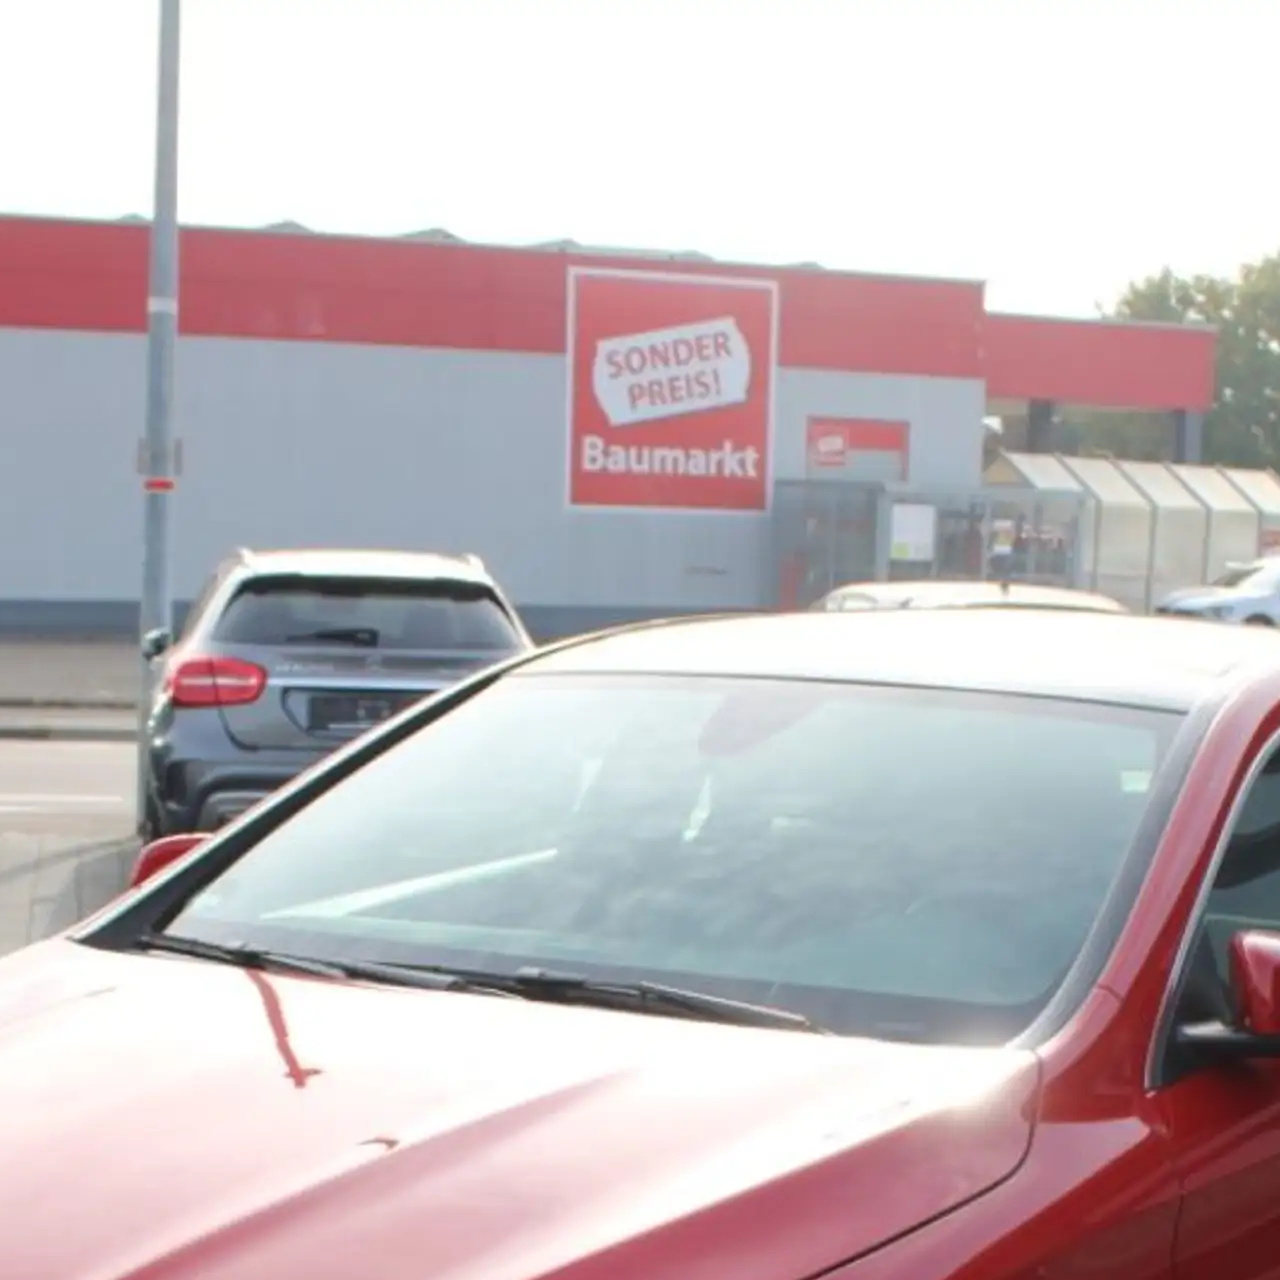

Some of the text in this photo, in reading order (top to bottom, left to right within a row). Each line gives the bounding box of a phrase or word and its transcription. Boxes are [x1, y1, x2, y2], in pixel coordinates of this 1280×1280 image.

[605, 331, 733, 380] SONDER
[627, 368, 721, 411] PREIS!
[581, 434, 760, 479] Baumarkt
